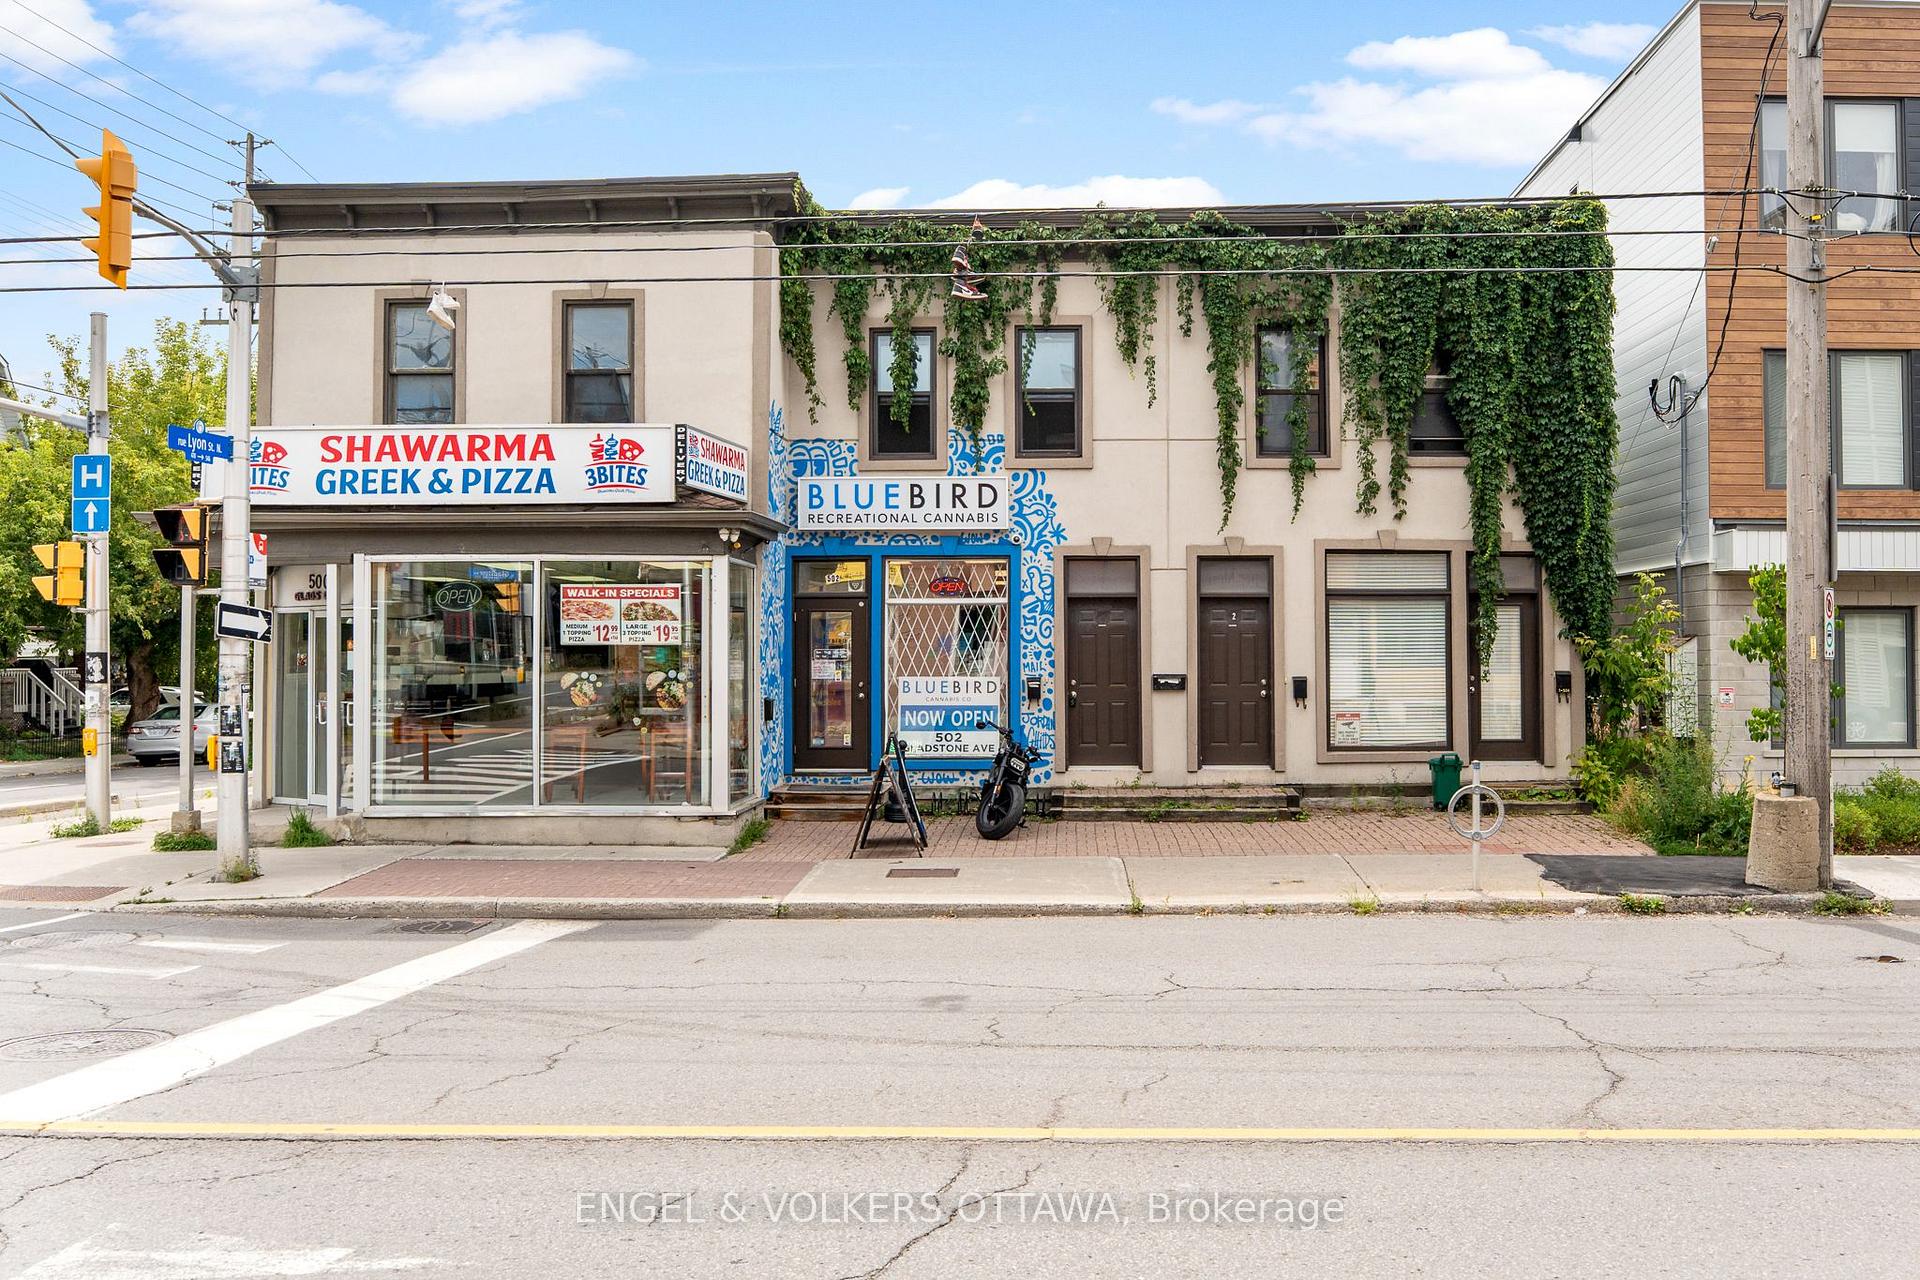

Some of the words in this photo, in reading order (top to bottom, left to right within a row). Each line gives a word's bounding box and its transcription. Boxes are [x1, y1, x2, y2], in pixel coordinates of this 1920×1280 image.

[188, 433, 207, 452] Lyon
[320, 433, 556, 463] SHAWARMA
[676, 427, 686, 482] DELIVERY
[700, 437, 745, 472] SHAWARMA
[81, 464, 103, 489] H
[250, 467, 290, 488] ITES
[315, 467, 421, 495] GREEK
[428, 467, 454, 495] &
[461, 467, 557, 495] PIZZA
[585, 464, 649, 487] 3BITES
[688, 459, 714, 487] GREEK
[714, 468, 722, 489] &
[722, 470, 745, 496] PIZZA
[808, 483, 998, 509] BLUEBIRD
[808, 513, 917, 524] RECREATIONAL
[923, 512, 998, 523] CANNABIS
[567, 588, 617, 598] WALK-IN
[619, 588, 675, 598] SPECIALS
[931, 582, 965, 593] OPEN
[438, 589, 478, 605] OPEN
[1231, 612, 1237, 621] 2
[1023, 661, 1047, 673] MAIL
[902, 680, 997, 694] BLUEBIRD
[905, 710, 946, 727] NOW
[951, 710, 994, 727] OPEN
[935, 732, 962, 743] 502
[972, 744, 995, 753] AVE
